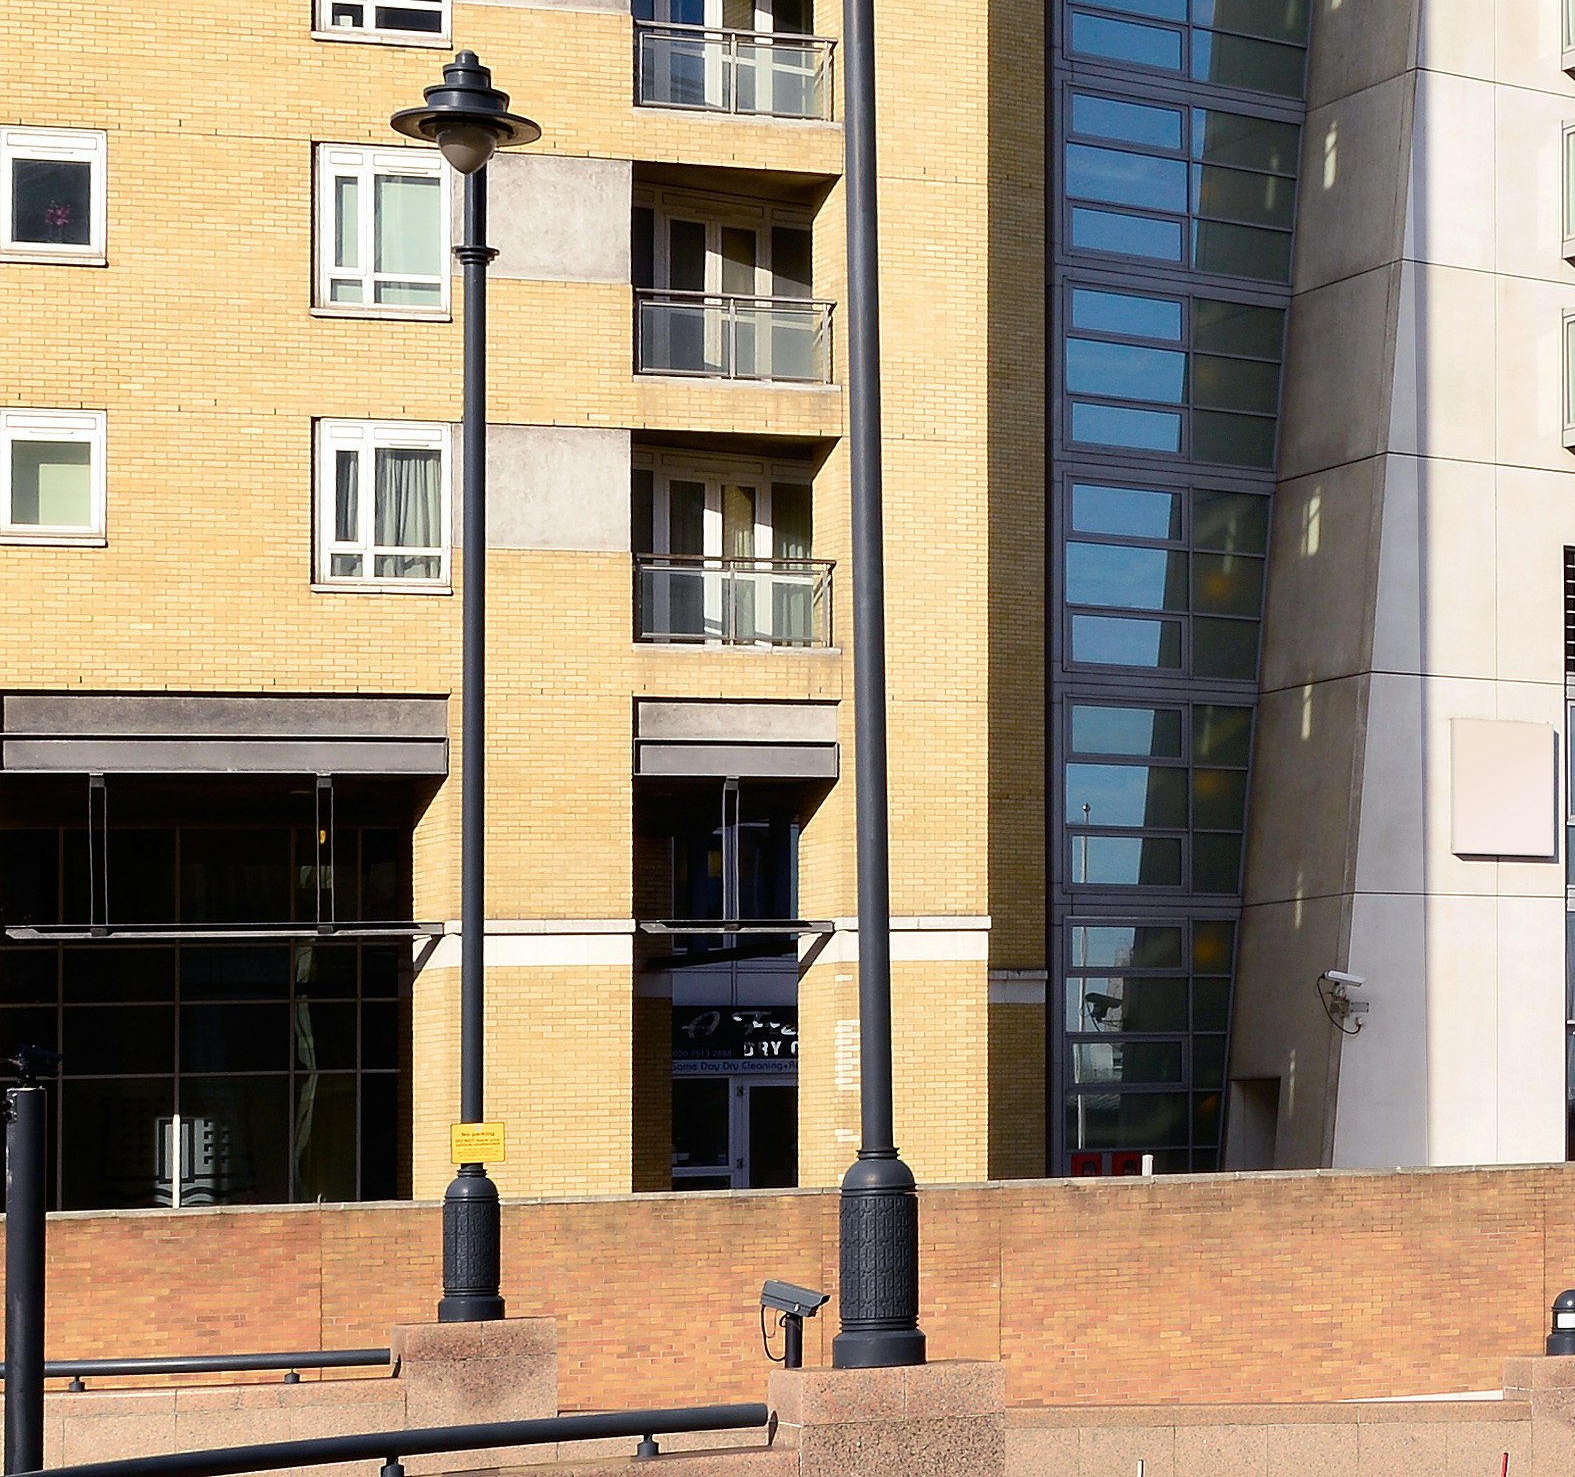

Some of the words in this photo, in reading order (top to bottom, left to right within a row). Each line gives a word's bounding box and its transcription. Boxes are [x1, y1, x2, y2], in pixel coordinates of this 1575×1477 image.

[743, 1041, 782, 1057] DRY
[701, 1062, 720, 1071] Day
[723, 1062, 738, 1071] Dry
[742, 1061, 783, 1071] Cleaning
